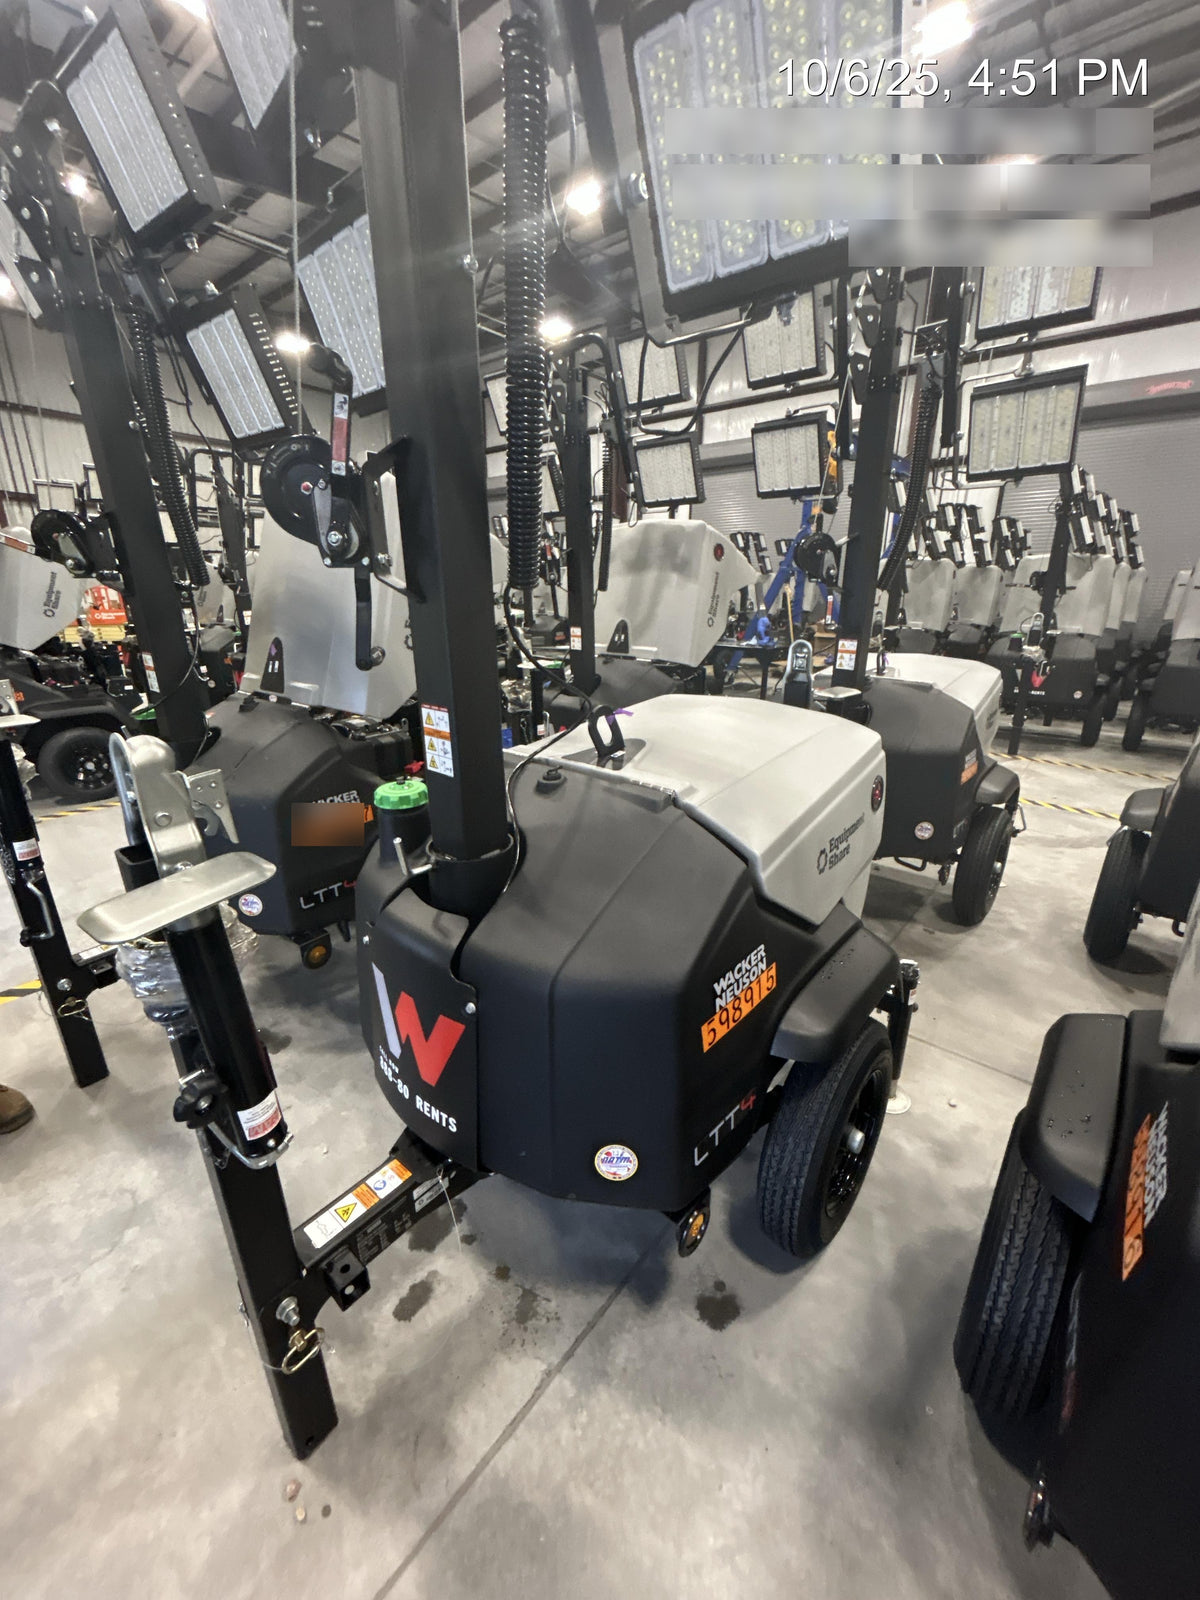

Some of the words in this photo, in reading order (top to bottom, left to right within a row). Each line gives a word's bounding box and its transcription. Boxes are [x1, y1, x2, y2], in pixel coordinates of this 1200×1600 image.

[829, 812, 865, 853] Equipment
[828, 843, 850, 870] Share
[713, 943, 767, 996] WACKER
[715, 957, 767, 1013] NEUSON
[706, 966, 775, 1047] 598915
[415, 1094, 458, 1133] RENTS
